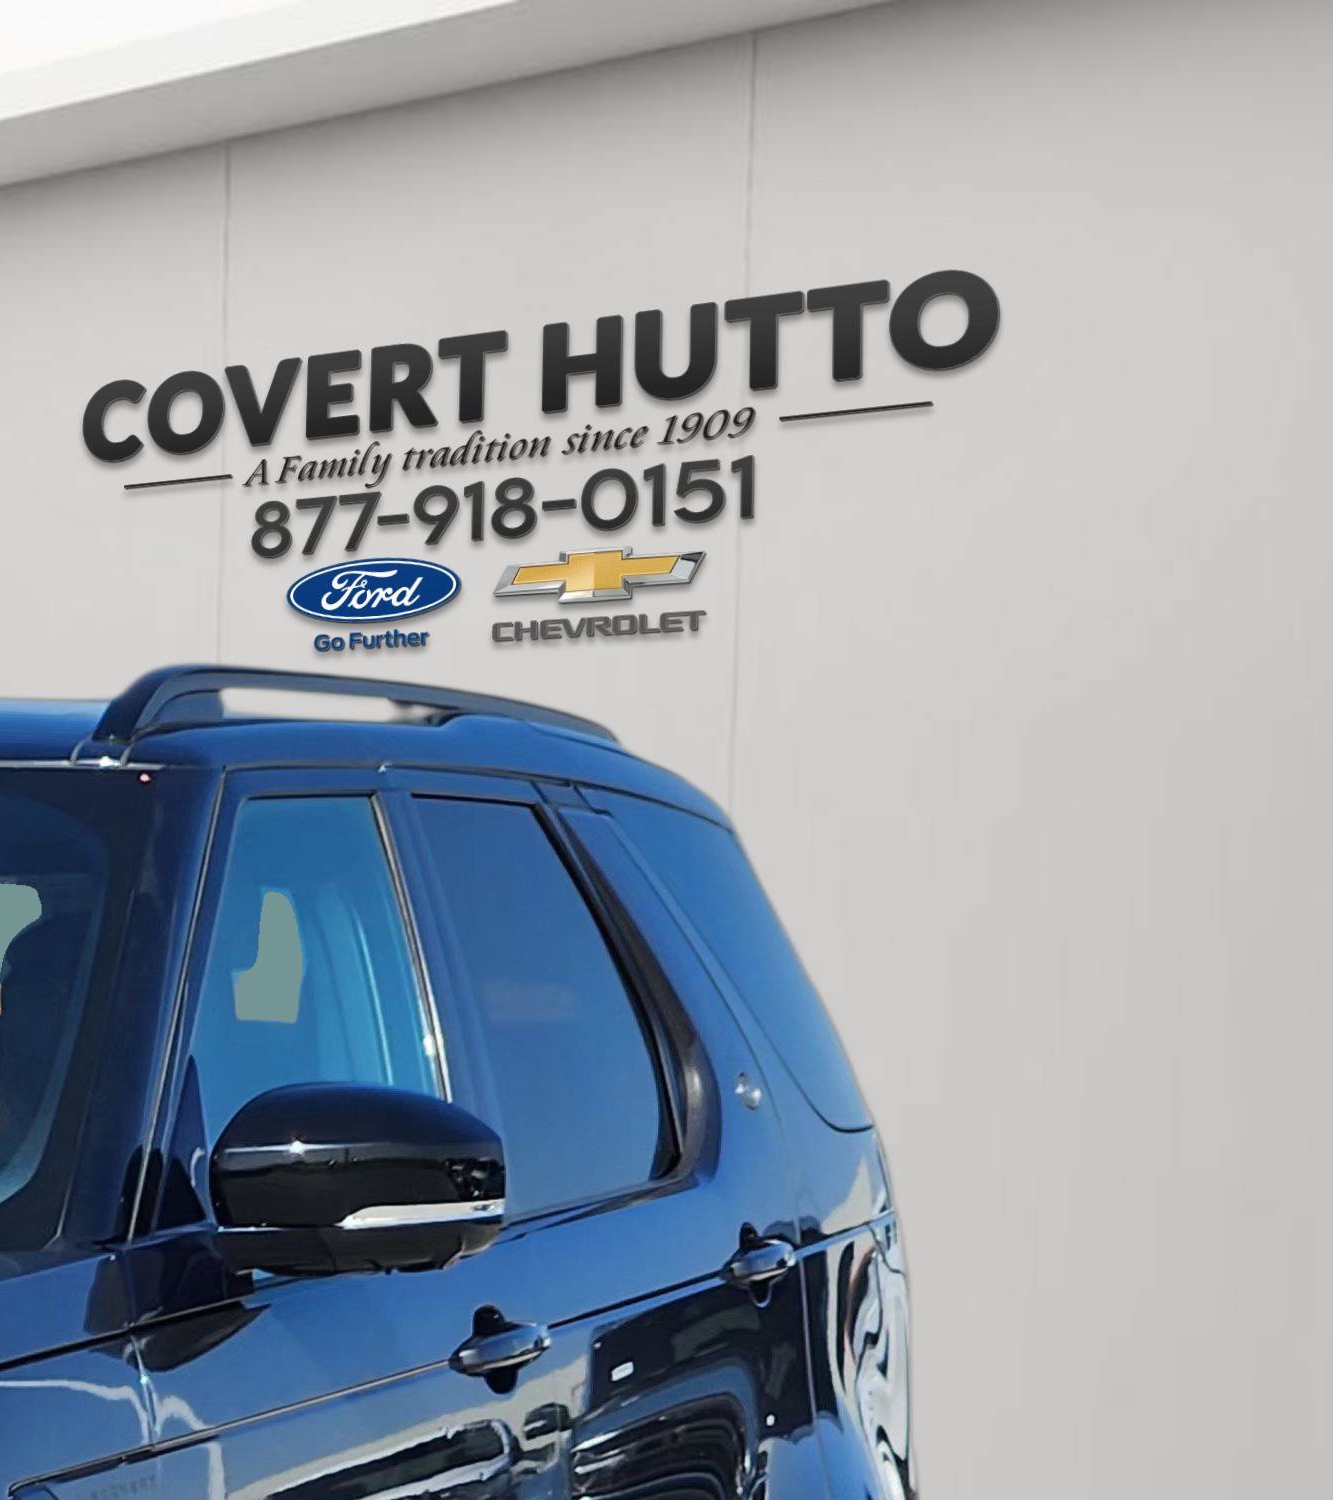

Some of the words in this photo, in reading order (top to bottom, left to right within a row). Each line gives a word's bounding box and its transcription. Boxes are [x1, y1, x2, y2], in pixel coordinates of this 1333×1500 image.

[81, 330, 509, 464] COVERT
[541, 269, 1001, 415] HUTTO
[242, 458, 269, 488] A
[275, 441, 393, 489] Family
[401, 429, 551, 472] tradition
[561, 423, 649, 457] since
[656, 406, 757, 446] 1909
[249, 455, 755, 559] 877-918-0151
[320, 569, 424, 611] Ford
[313, 633, 346, 653] Go
[349, 629, 430, 651] Further
[491, 610, 707, 643] CHEVROLET
